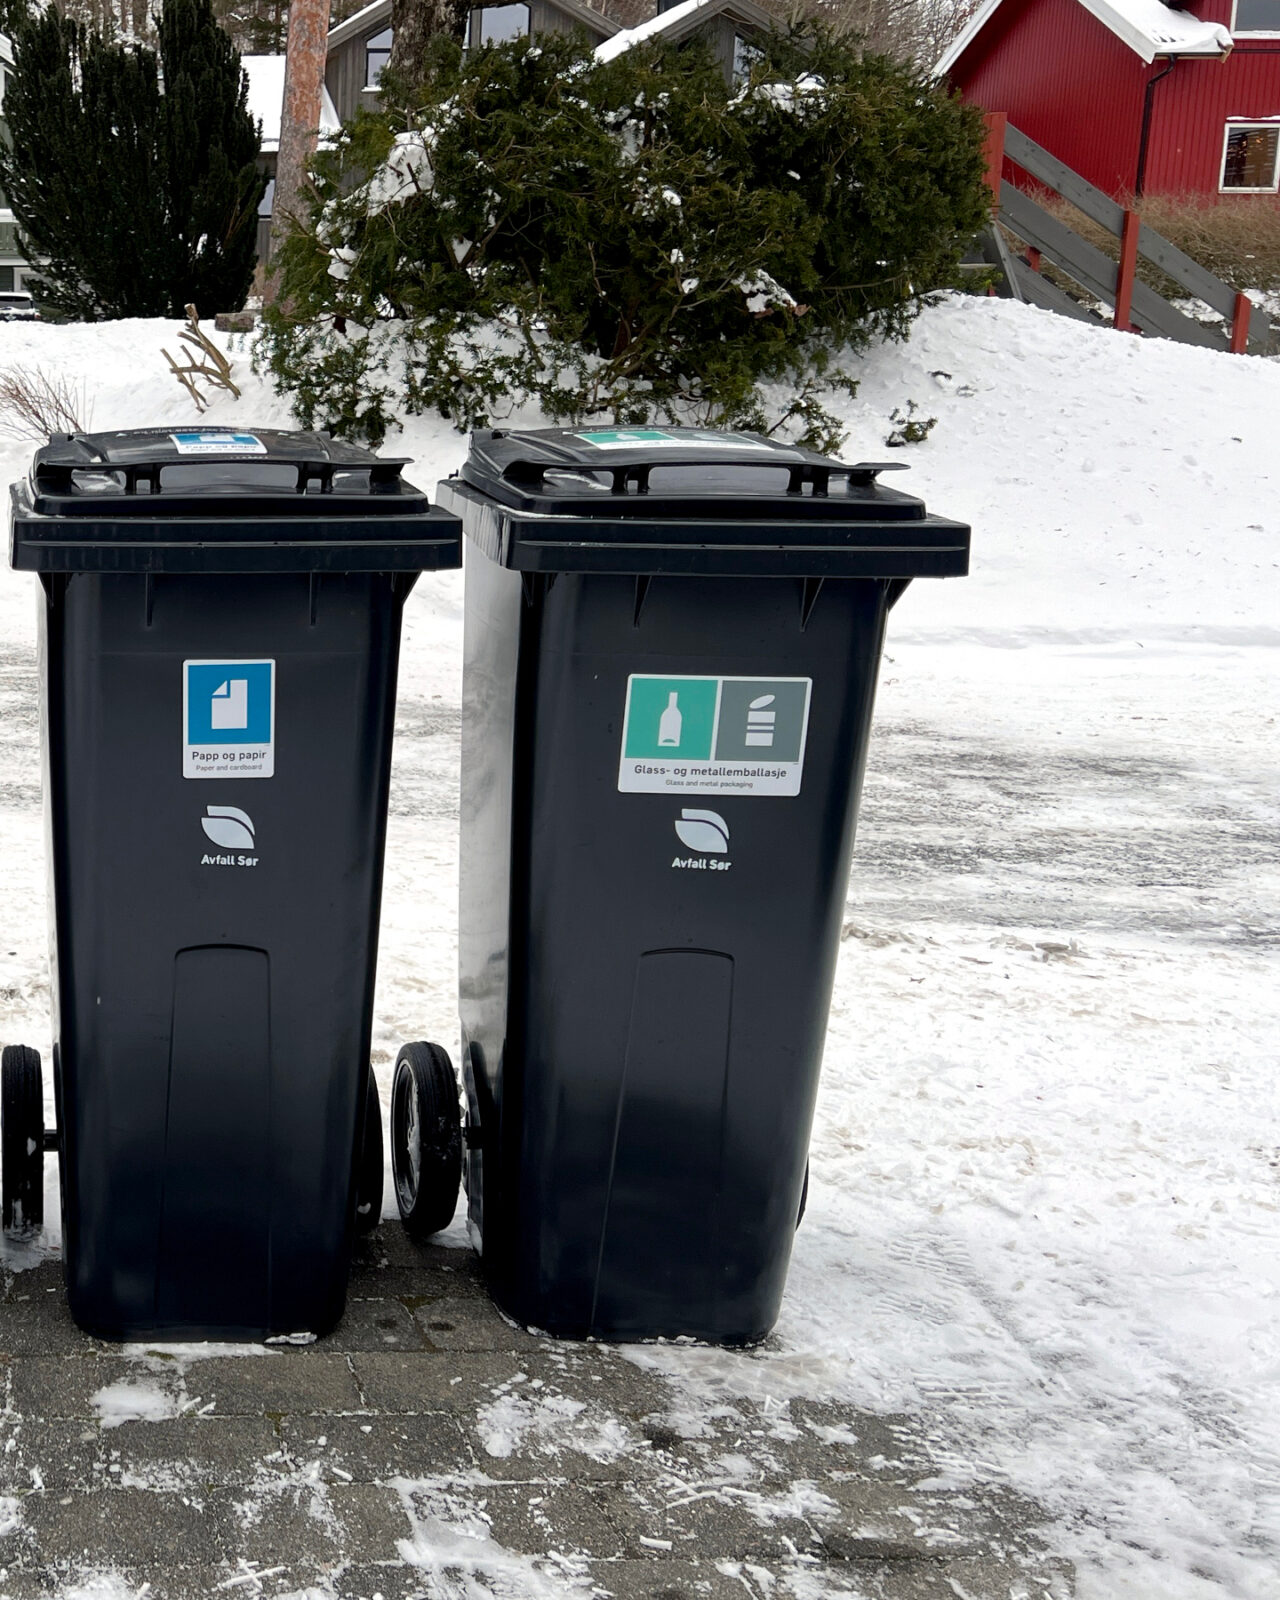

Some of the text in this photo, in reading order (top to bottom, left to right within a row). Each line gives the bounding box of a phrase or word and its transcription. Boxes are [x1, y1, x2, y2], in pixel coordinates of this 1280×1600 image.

[191, 750, 267, 762] Papp og papir
[195, 764, 215, 772] Paper
[634, 764, 787, 780] Glass- og metallemballasje
[665, 779, 684, 787] Glass
[699, 779, 719, 787] metal
[720, 780, 754, 789] packaging
[200, 854, 235, 866] Avfall
[671, 857, 707, 870] Avfall
